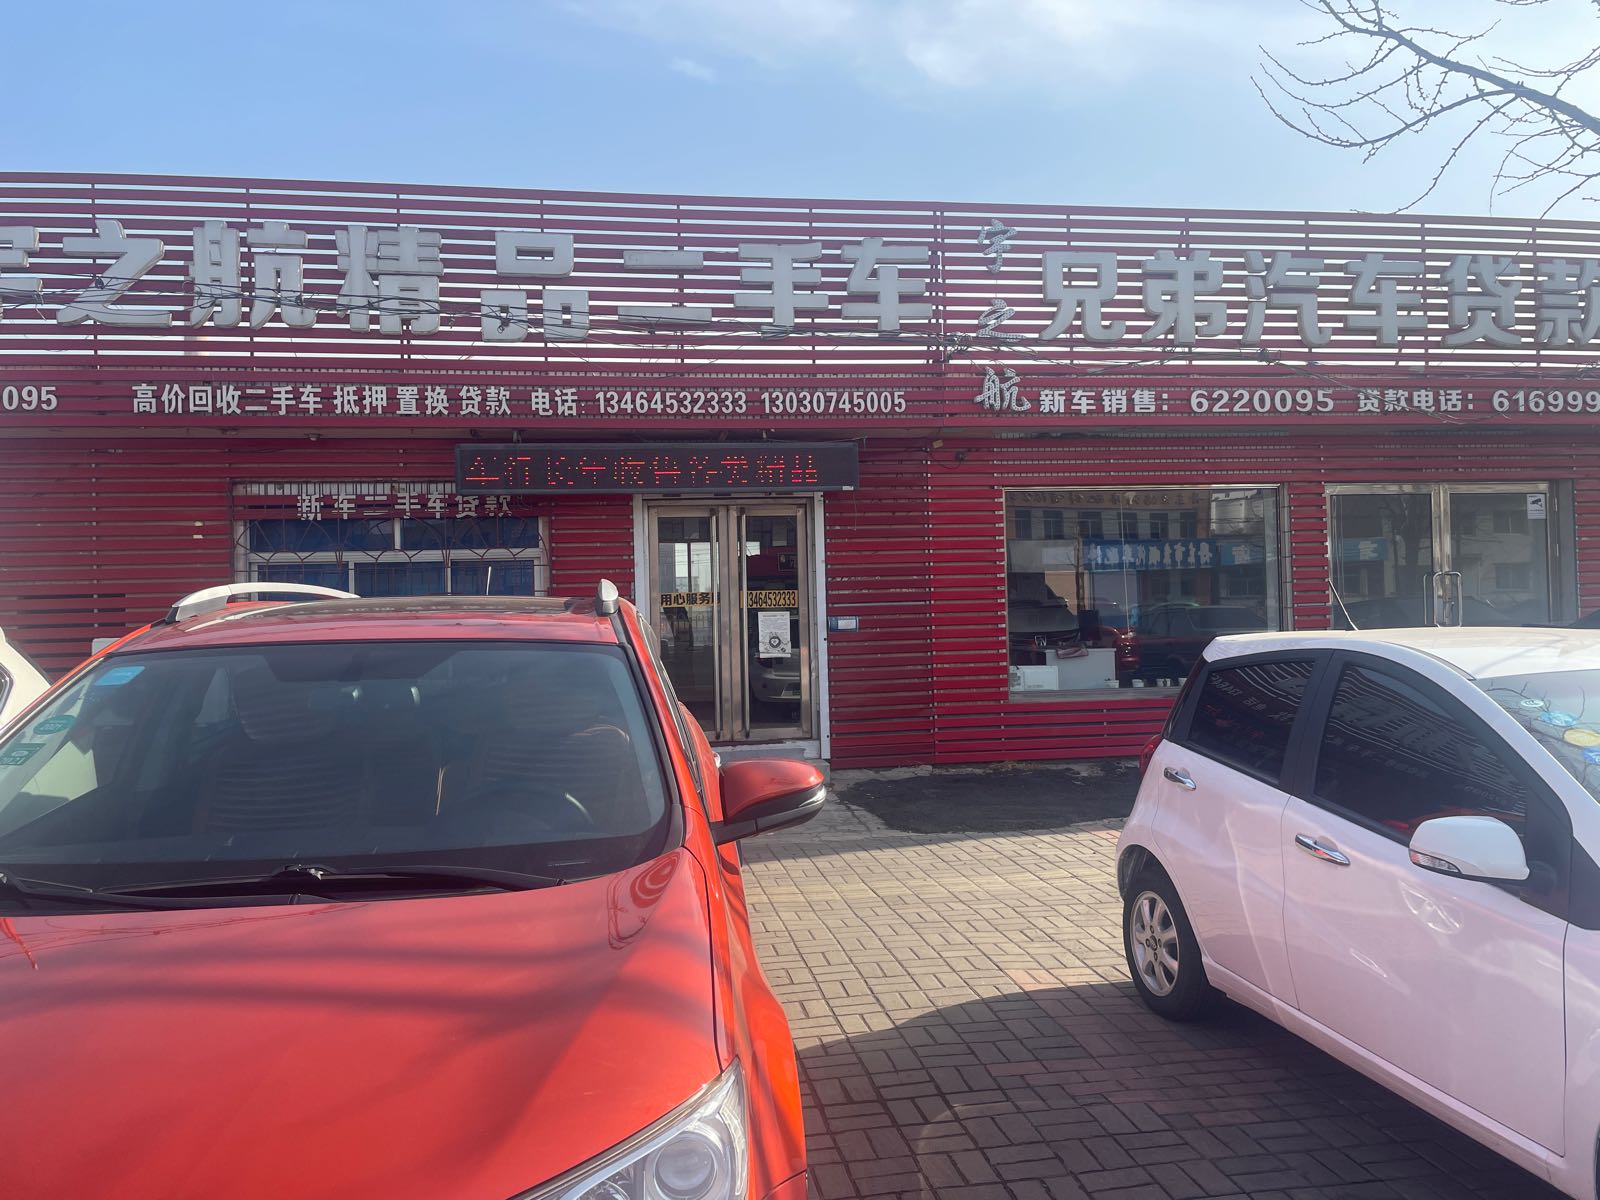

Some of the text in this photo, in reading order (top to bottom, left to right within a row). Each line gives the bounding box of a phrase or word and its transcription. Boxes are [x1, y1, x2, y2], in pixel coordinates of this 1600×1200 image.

[1040, 248, 1600, 348] 兄弟汽车贷款
[132, 383, 323, 416] 高价回收二手车
[333, 384, 388, 415] 抵押
[396, 385, 450, 416] 置换
[458, 385, 512, 416] 贷款
[595, 391, 748, 414] 13464532333
[760, 391, 907, 414] 13030745005
[1190, 388, 1335, 413] 6220095
